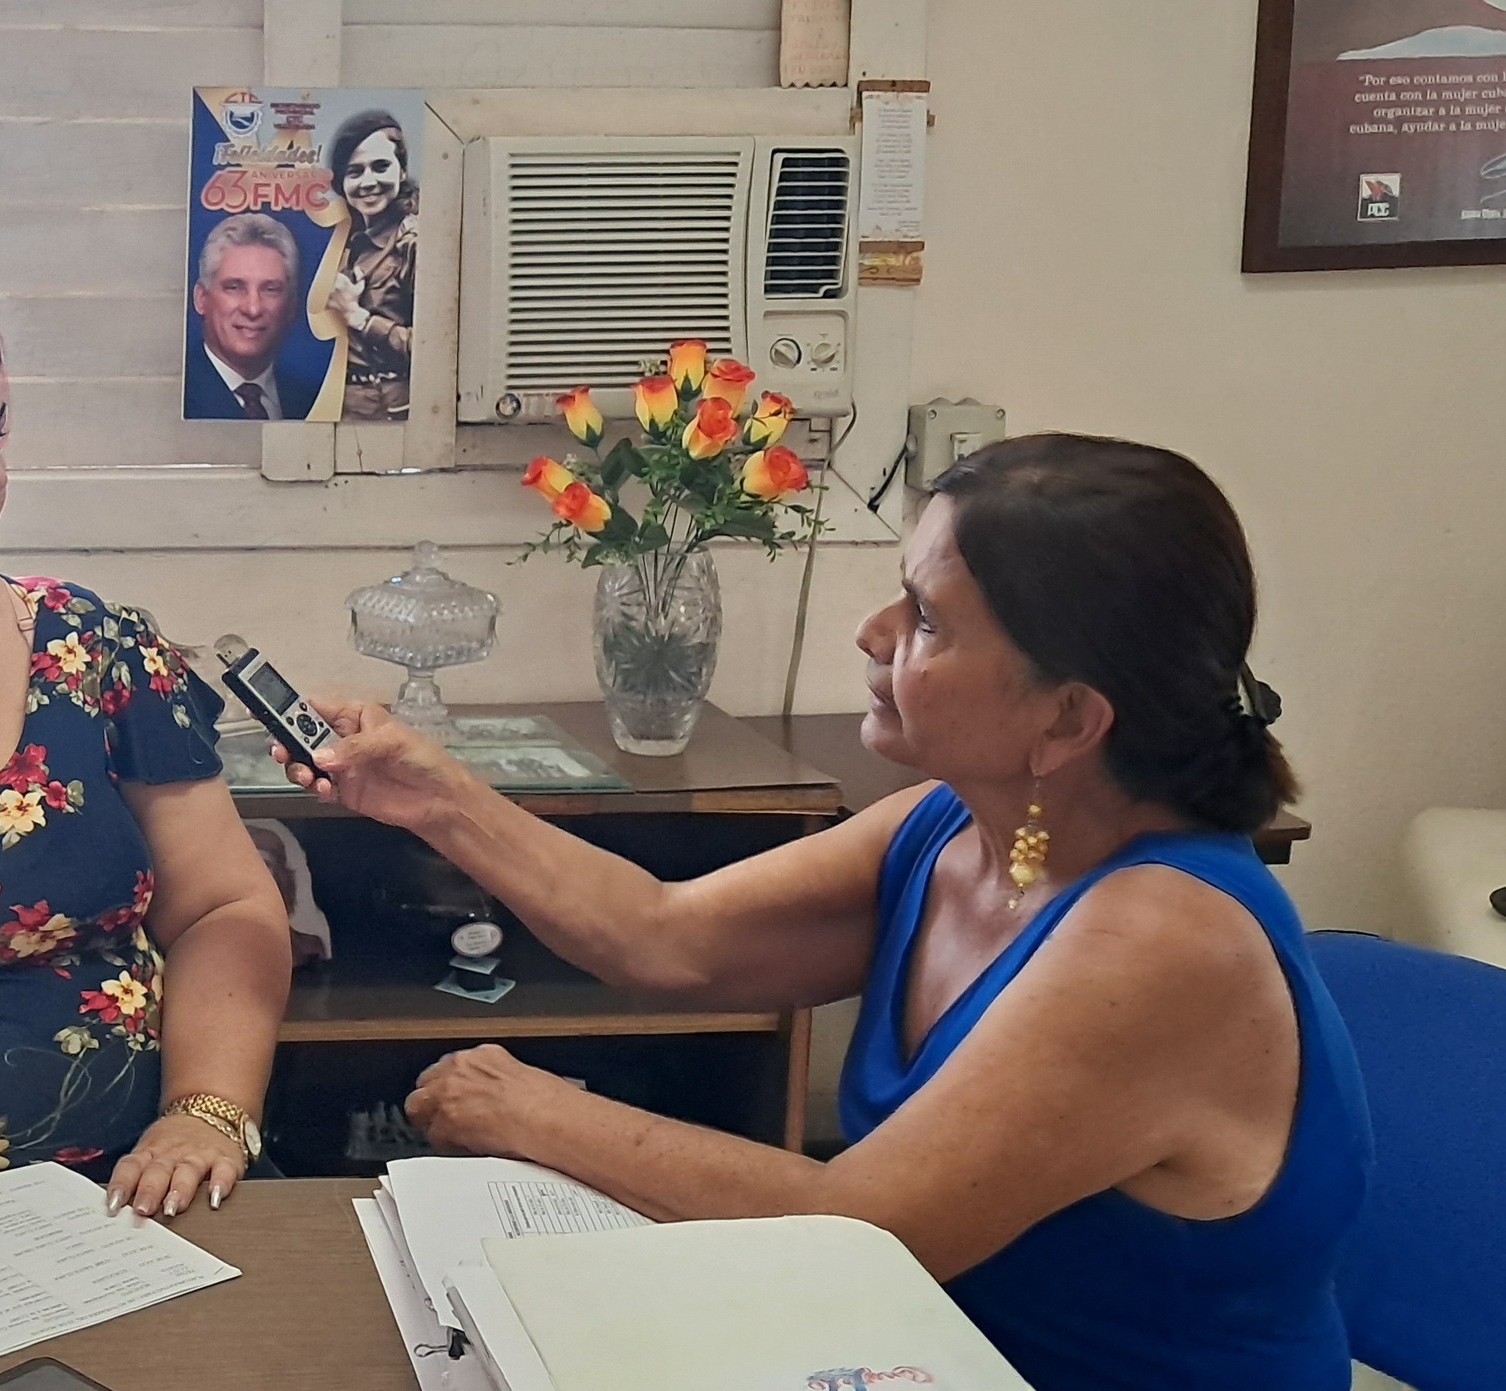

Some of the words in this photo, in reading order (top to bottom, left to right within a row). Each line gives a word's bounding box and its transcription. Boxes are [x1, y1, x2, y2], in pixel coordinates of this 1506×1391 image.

[1414, 73, 1473, 85] contamos
[1477, 73, 1498, 84] con
[1355, 91, 1396, 102] cuenta
[1400, 91, 1423, 101] con
[1426, 89, 1438, 100] la
[1442, 87, 1478, 102] mujer
[1373, 105, 1435, 119] organizar
[1439, 107, 1447, 116] a
[1449, 104, 1461, 115] la
[1464, 103, 1501, 118] mujer
[1350, 122, 1398, 134] cubana,
[1401, 120, 1446, 134] ayudar
[1449, 121, 1457, 131] a
[1460, 120, 1472, 131] la
[203, 170, 247, 210] 63
[251, 170, 330, 180] ANIVERSAR
[253, 182, 330, 211] FMC
